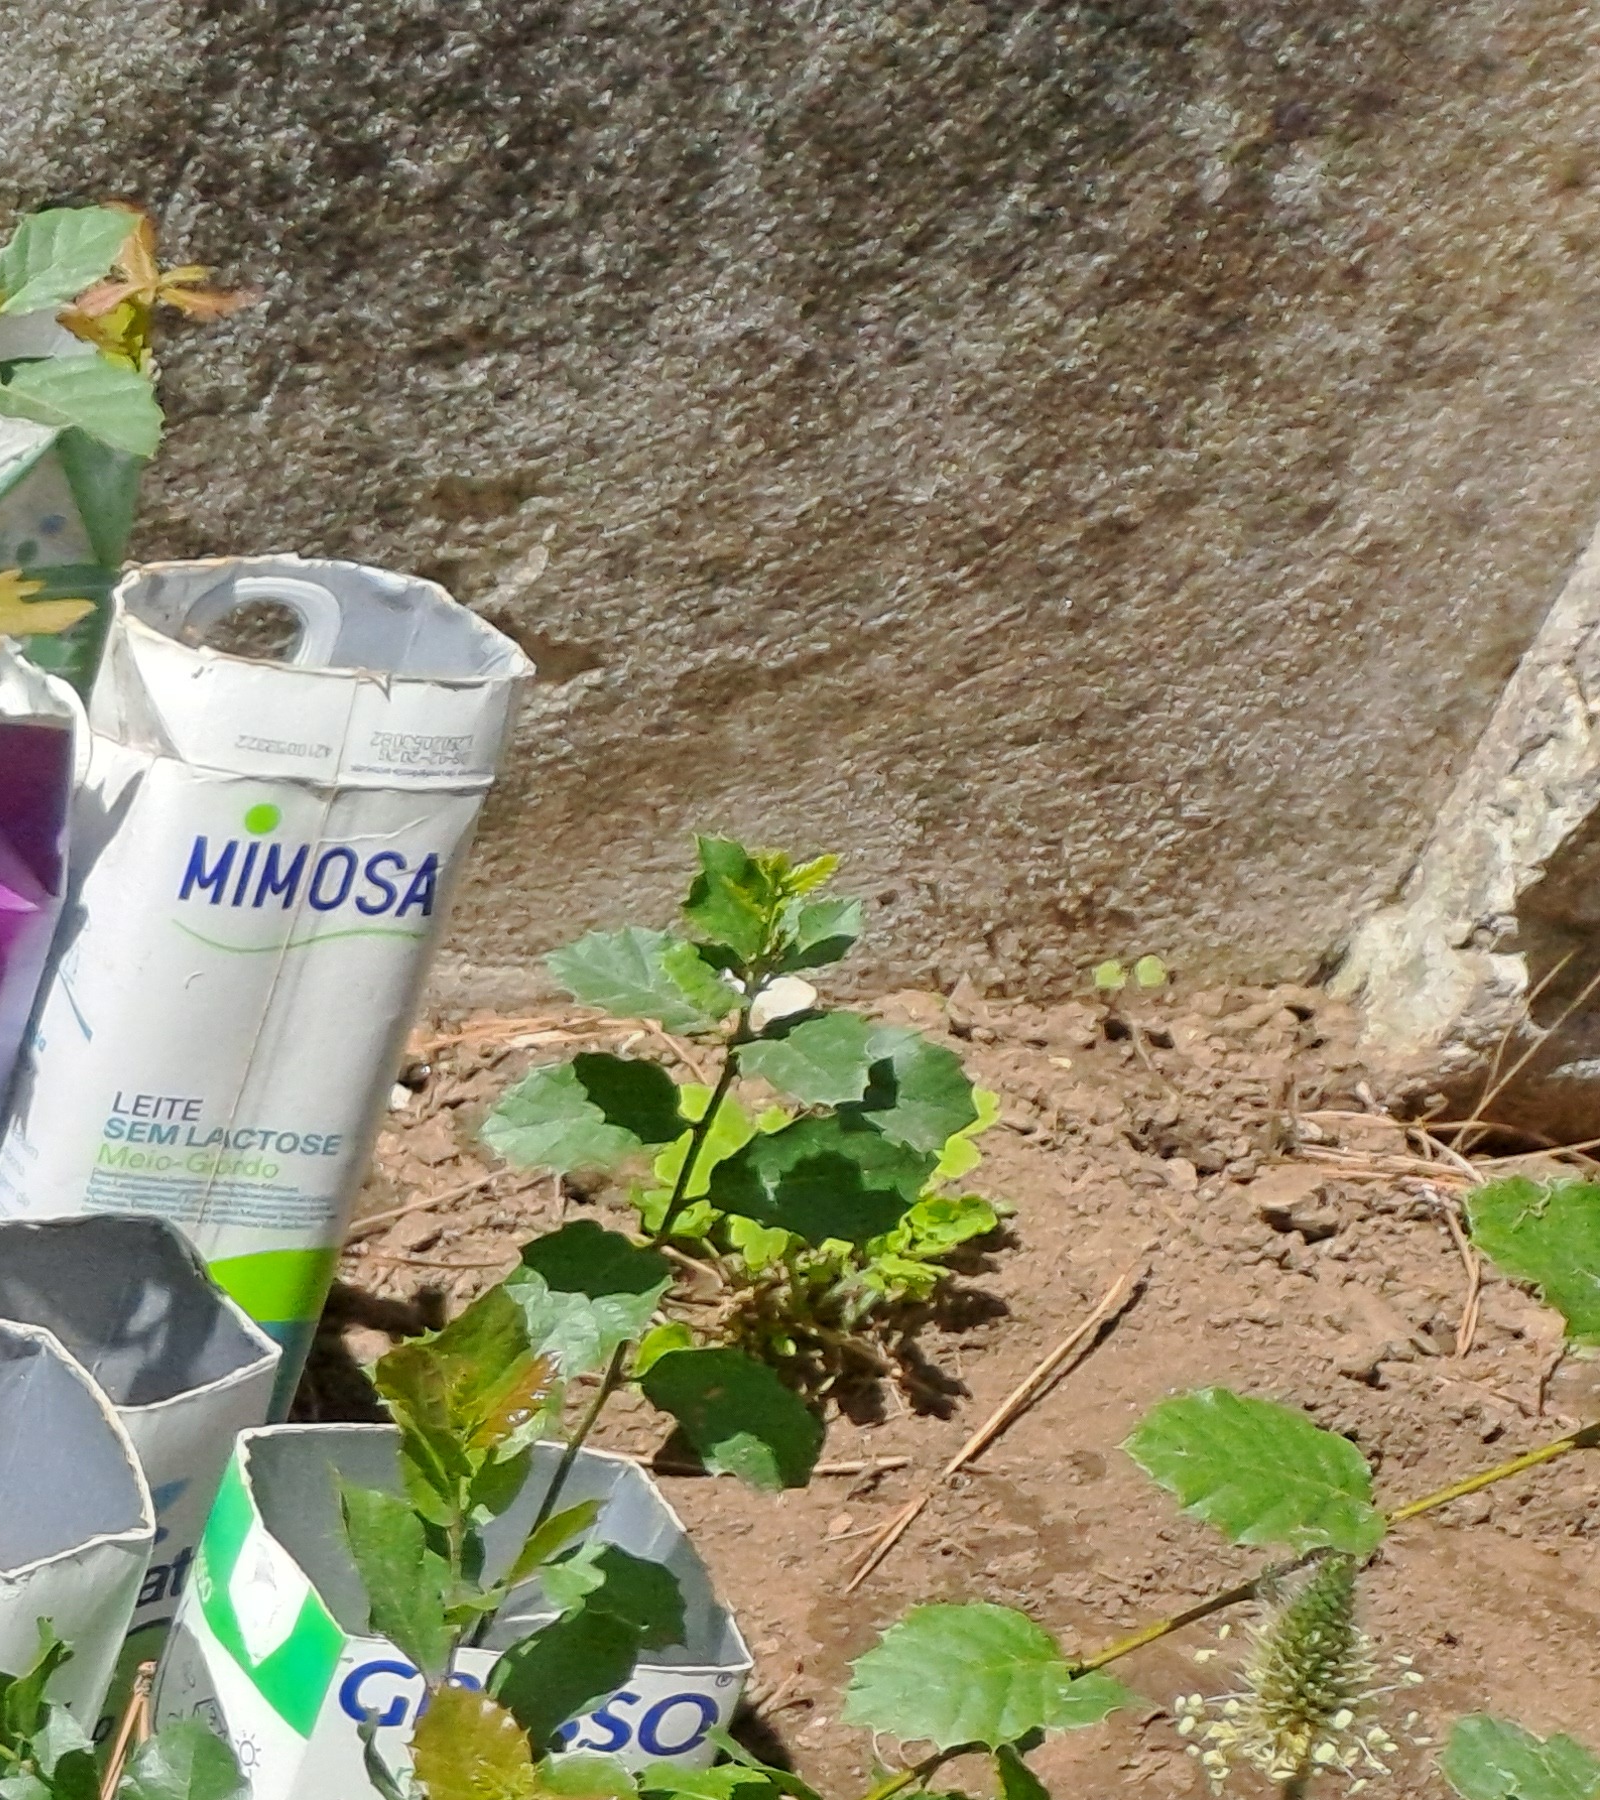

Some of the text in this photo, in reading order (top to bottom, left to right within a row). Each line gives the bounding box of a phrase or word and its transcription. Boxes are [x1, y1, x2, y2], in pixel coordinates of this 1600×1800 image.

[178, 835, 440, 918] MIMOSA
[111, 1090, 204, 1122] LEITE
[102, 1116, 344, 1158] SEM LACTOSE
[98, 1139, 281, 1179] Meio-Gordo
